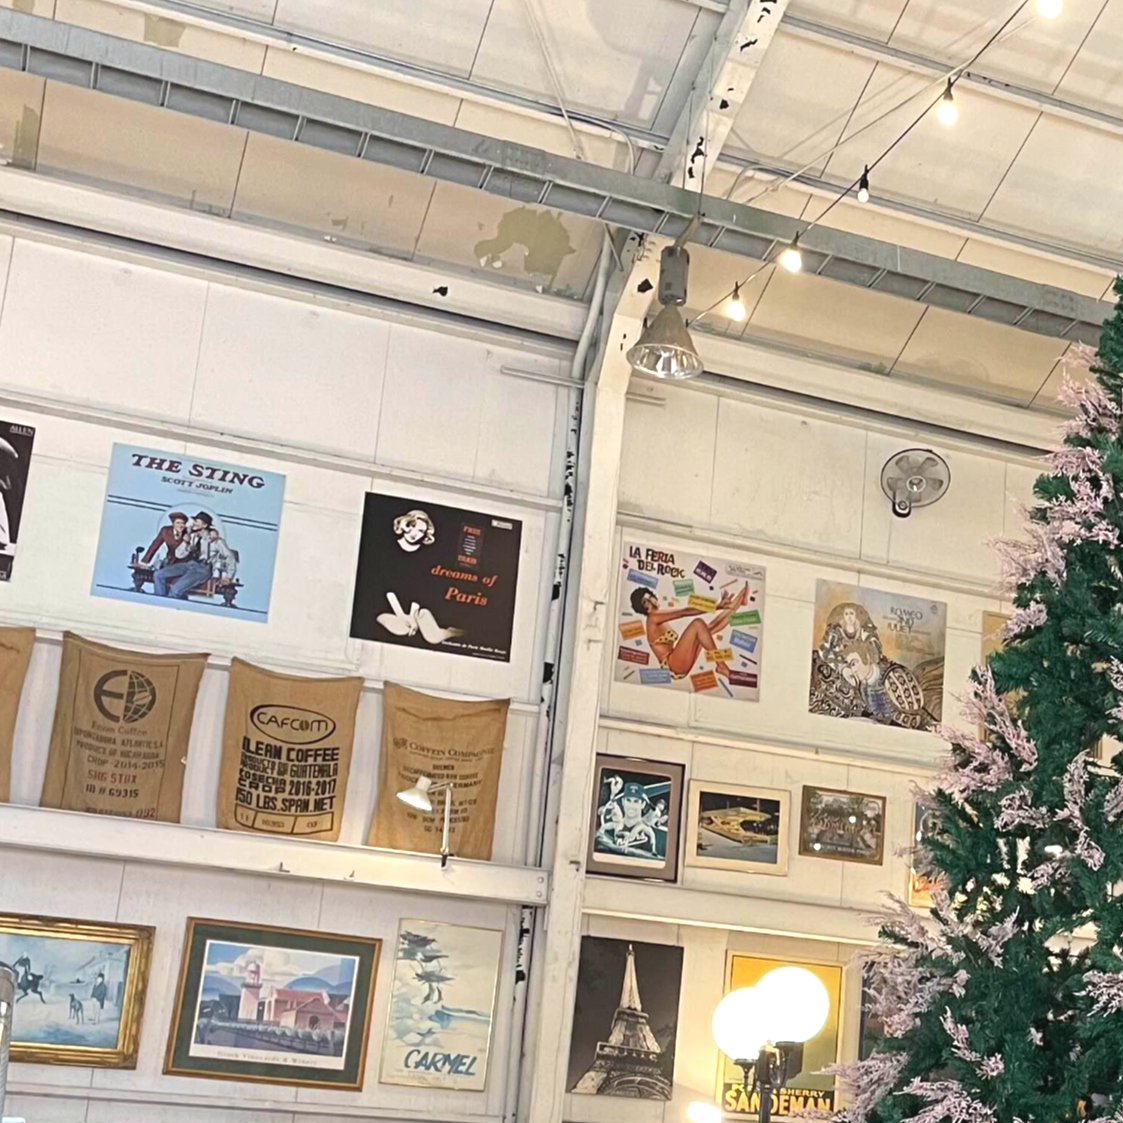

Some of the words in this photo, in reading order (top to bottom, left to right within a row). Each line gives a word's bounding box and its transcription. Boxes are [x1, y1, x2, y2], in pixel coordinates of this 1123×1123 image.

[131, 453, 183, 474] THE
[187, 464, 266, 490] STING
[161, 475, 194, 489] SCOTT
[195, 481, 234, 495] JOPLIN
[629, 545, 642, 560] LA
[645, 548, 675, 565] FERIA
[430, 564, 479, 582] dreams
[482, 574, 499, 588] of
[636, 559, 656, 571] DEL
[656, 563, 686, 579] ROCK
[444, 587, 489, 606] Paris
[890, 606, 924, 620] ROMEO
[256, 711, 329, 732] CAFCOM
[286, 747, 340, 763] COFFEE
[239, 768, 287, 787] COSECHA
[289, 763, 339, 779] GUATEMALA
[237, 777, 286, 795] CROP
[288, 778, 337, 797] 2016-2017
[403, 1048, 478, 1076] CARMEL
[725, 1090, 831, 1115] SANDEMAN
[780, 1087, 825, 1098] SHERRY
